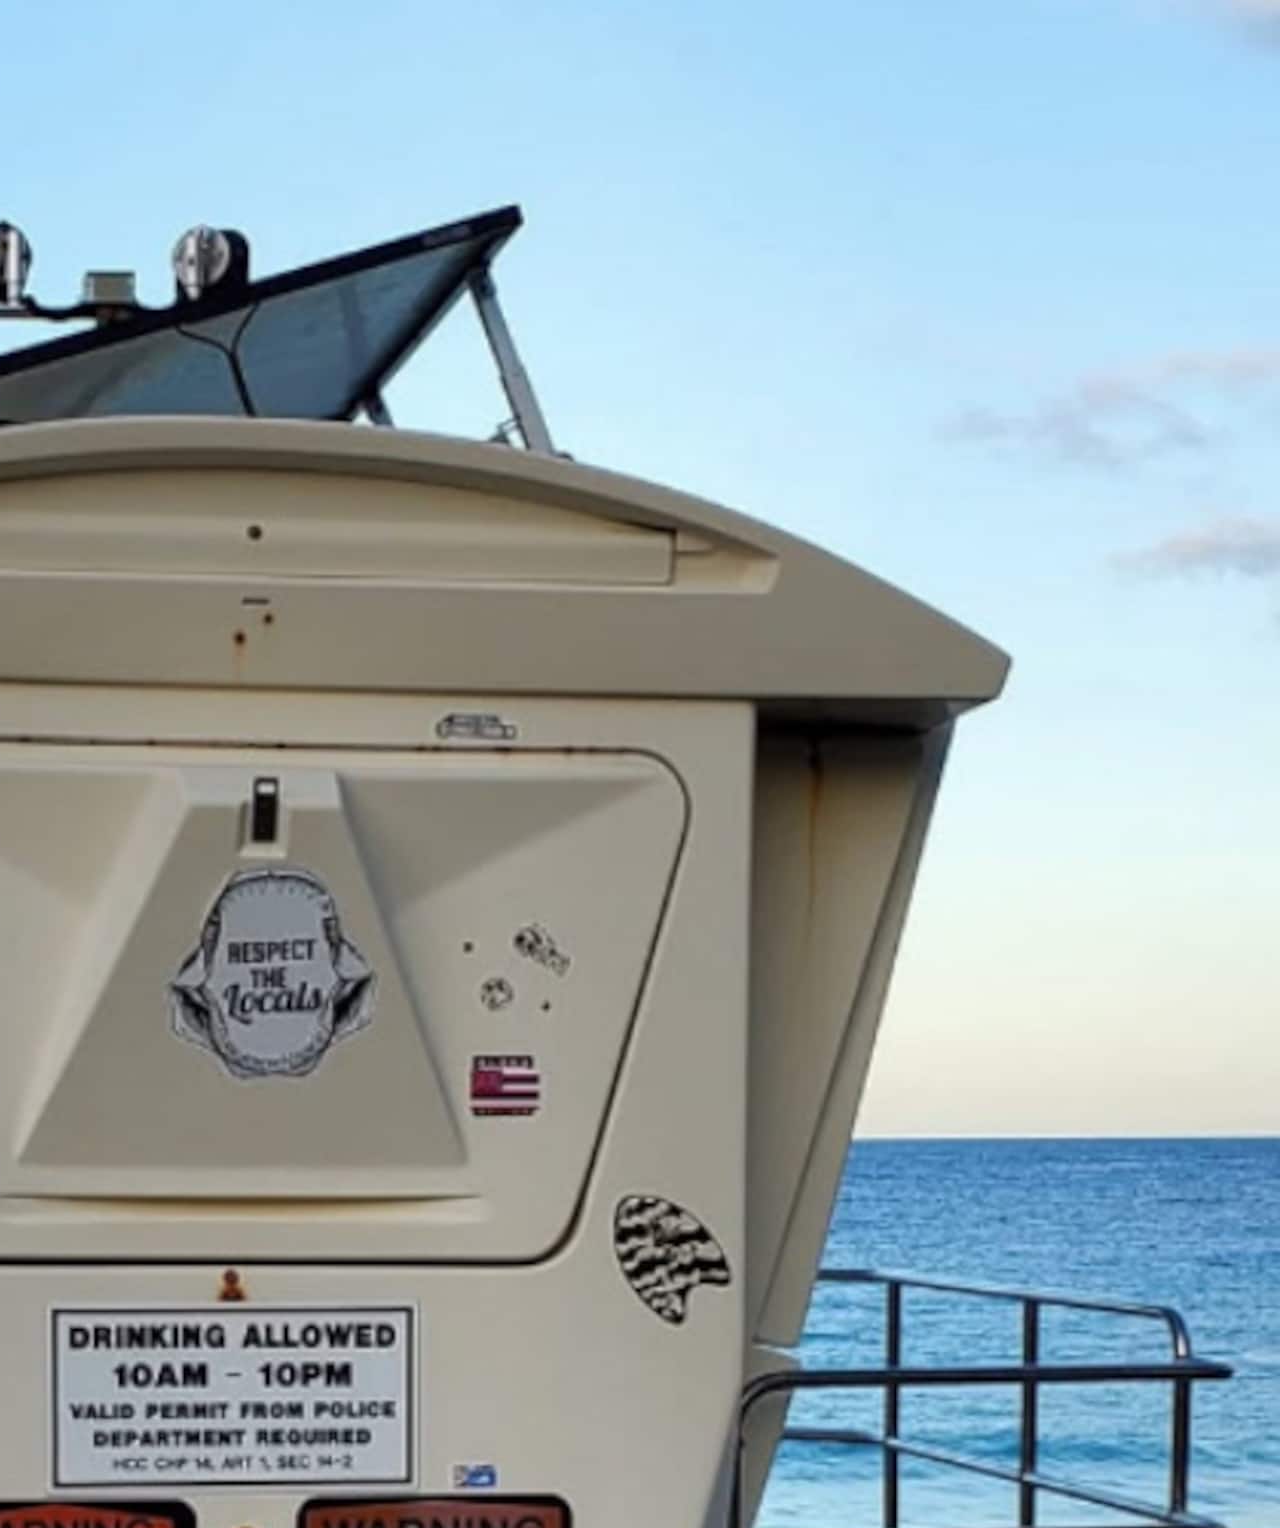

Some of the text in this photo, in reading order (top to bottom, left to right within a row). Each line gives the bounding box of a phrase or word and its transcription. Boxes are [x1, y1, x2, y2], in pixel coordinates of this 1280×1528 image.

[227, 939, 317, 964] RESPECT
[250, 966, 287, 989] THE
[223, 981, 321, 1025] Locals
[69, 1322, 396, 1350] DRINKING ALLOWED
[113, 1361, 209, 1388] 10AM
[258, 1361, 353, 1388] 10PM
[70, 1401, 396, 1420] VALID PERMIT FROM POLICE
[93, 1428, 371, 1447] DEPARTMENT REQUIRED
[277, 1454, 311, 1469] SEC
